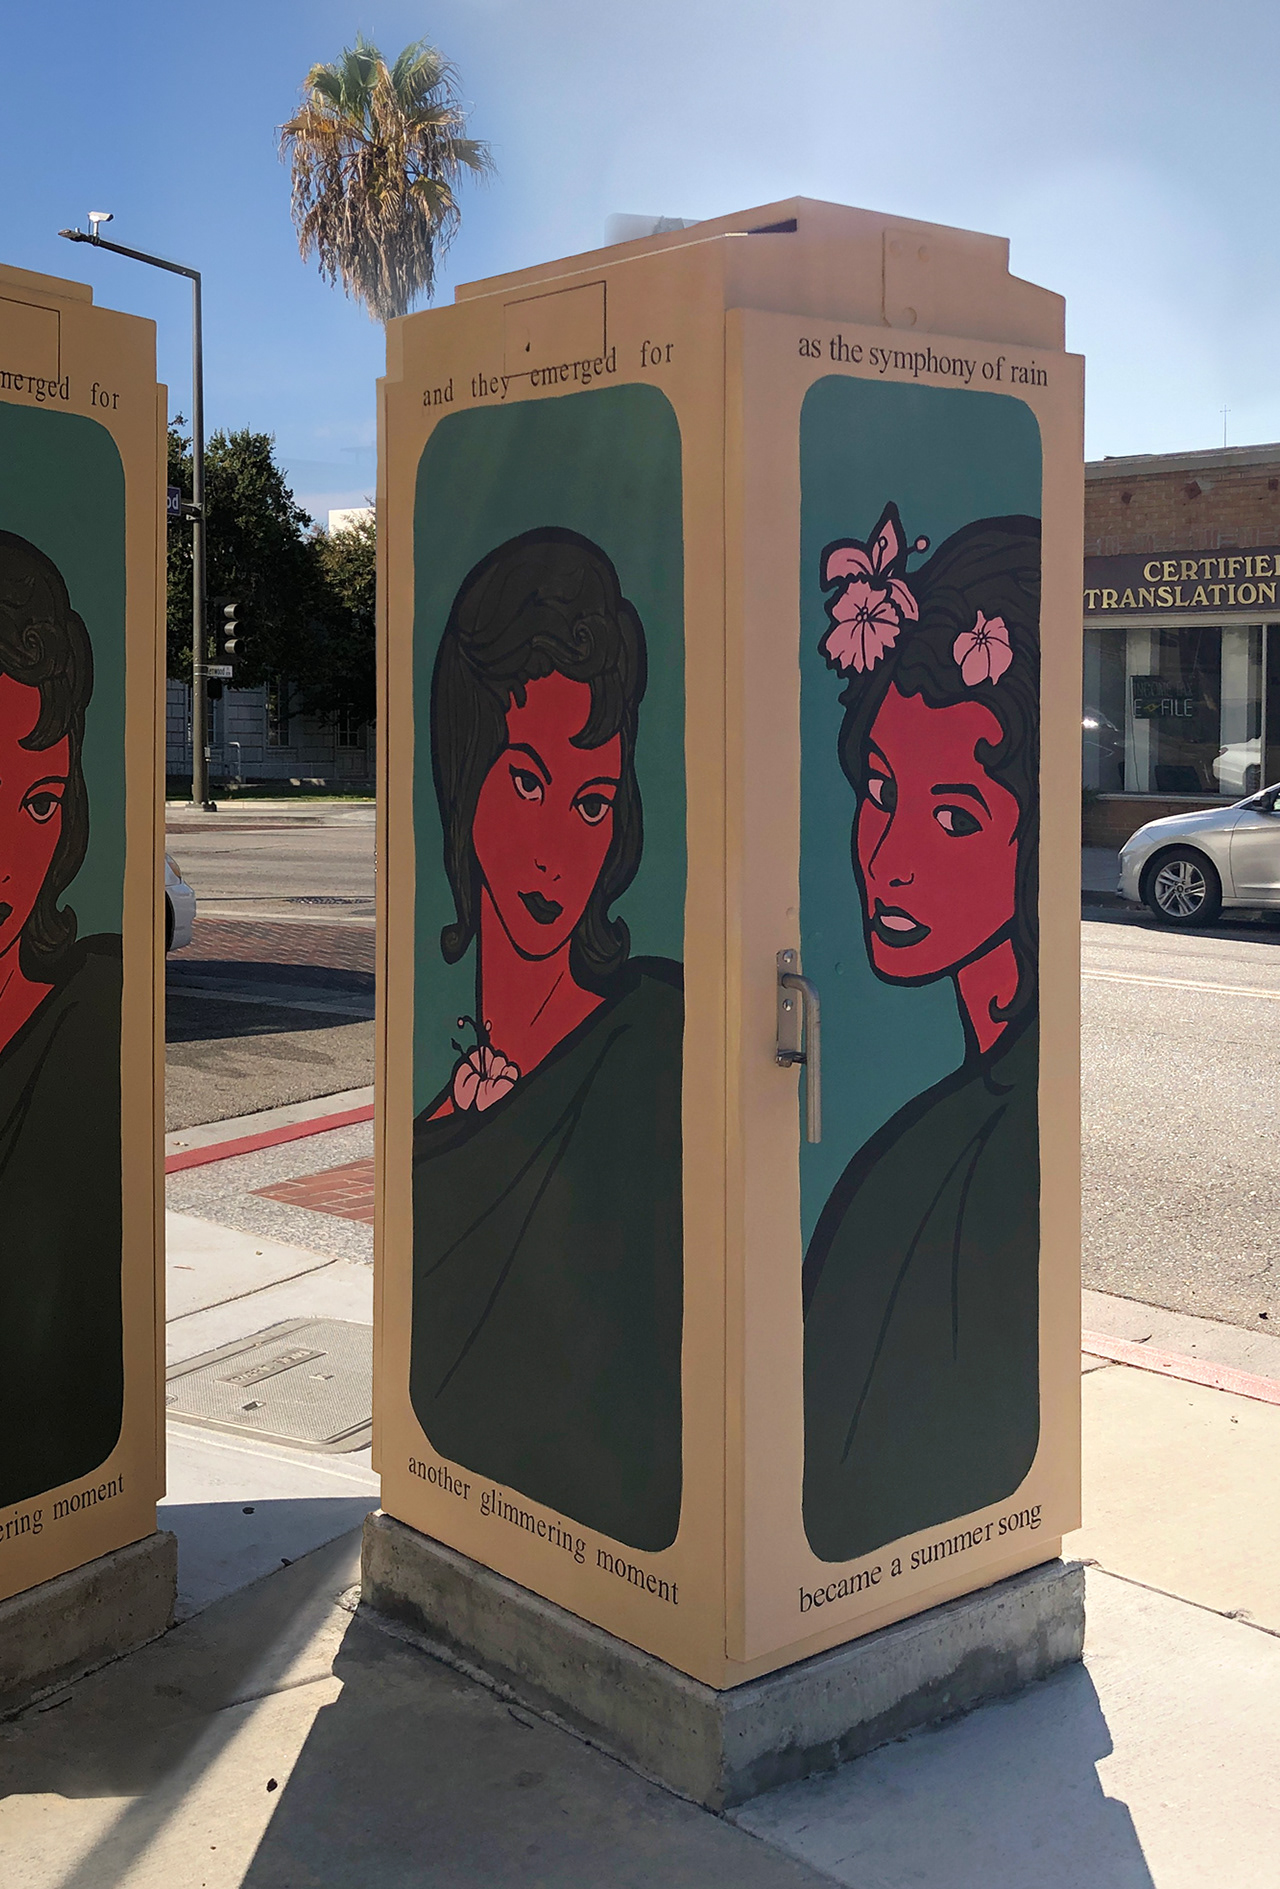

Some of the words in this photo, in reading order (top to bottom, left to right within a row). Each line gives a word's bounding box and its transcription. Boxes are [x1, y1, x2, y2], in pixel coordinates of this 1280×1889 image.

[422, 379, 454, 406] and
[471, 372, 510, 399] they
[529, 346, 617, 387] emerged
[640, 340, 674, 367] for
[798, 337, 822, 358] as
[829, 334, 863, 363] the
[869, 347, 977, 384] symphony
[982, 356, 1006, 381] of
[1010, 360, 1049, 387] rain
[90, 382, 120, 409] for
[1084, 582, 1277, 609] TRANSLATION
[1161, 699, 1193, 716] FILE
[52, 1473, 124, 1520] moment
[408, 1456, 471, 1500] another
[480, 1489, 587, 1564] glimmering
[596, 1549, 679, 1605] moment
[799, 1566, 882, 1613] became
[890, 1558, 903, 1577] a
[910, 1522, 994, 1570] summer
[998, 1504, 1042, 1536] song
